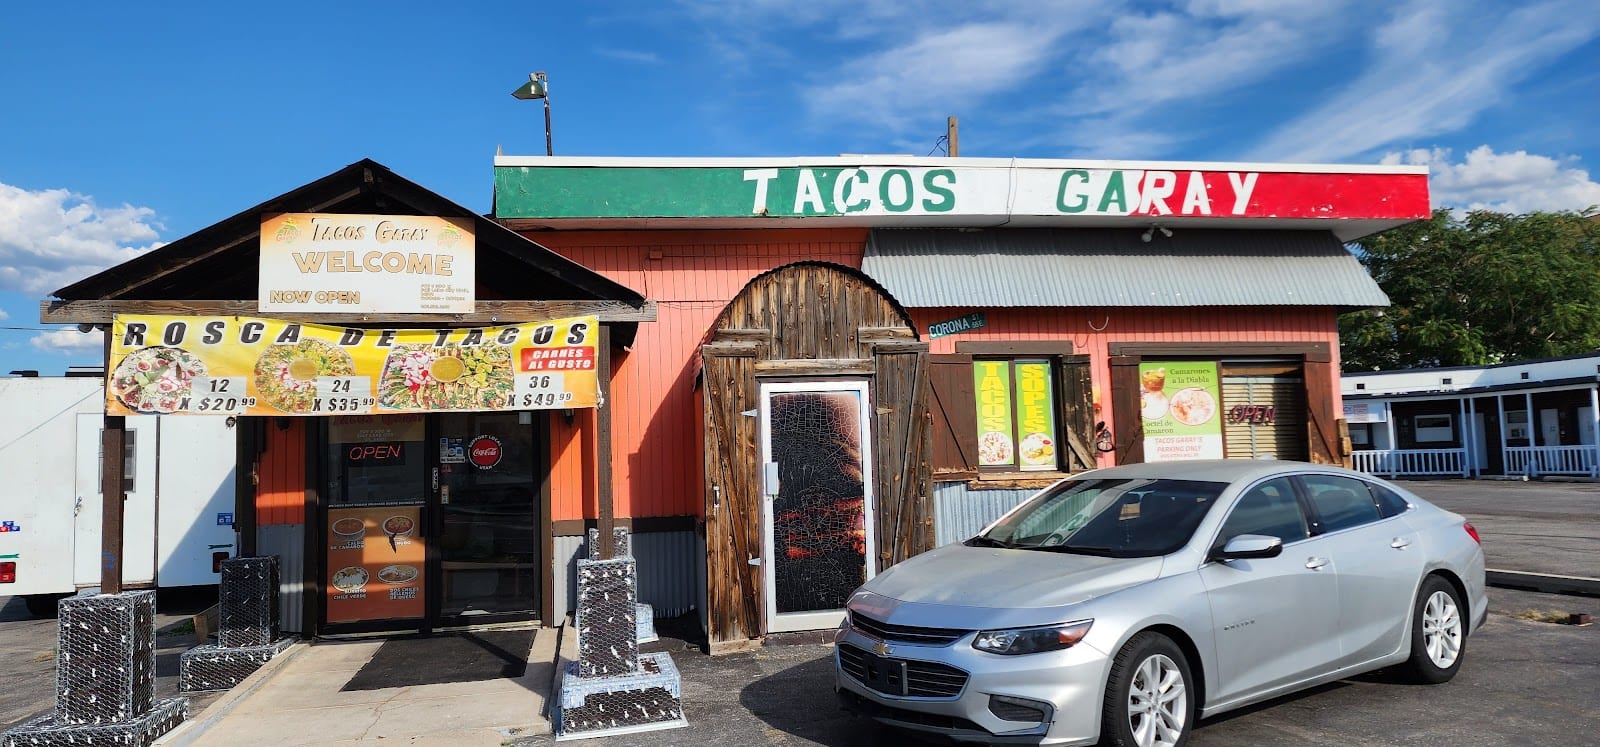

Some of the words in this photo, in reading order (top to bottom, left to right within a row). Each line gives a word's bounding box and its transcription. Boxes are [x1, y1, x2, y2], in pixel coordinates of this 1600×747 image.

[743, 168, 956, 214] TACOS
[1056, 169, 1259, 215] GARAY
[291, 250, 453, 276] WELCOME
[270, 290, 312, 304] NOW
[315, 290, 361, 305] OPEN
[123, 320, 302, 347] ROSCA
[338, 328, 397, 347] DE
[435, 322, 588, 347] TACOS
[928, 317, 970, 337] CORONA
[532, 348, 584, 359] CARNES
[528, 361, 543, 370] AL
[547, 359, 591, 369] GUSTO
[210, 379, 230, 393] 12
[331, 379, 351, 393] 24
[529, 375, 550, 388] 36
[178, 397, 192, 410] X
[506, 394, 516, 407] X
[979, 362, 1006, 432] TACOS
[1021, 363, 1047, 433] SOPES
[312, 398, 322, 412] X
[1231, 403, 1276, 424] OPEN
[349, 445, 401, 460] OPEN
